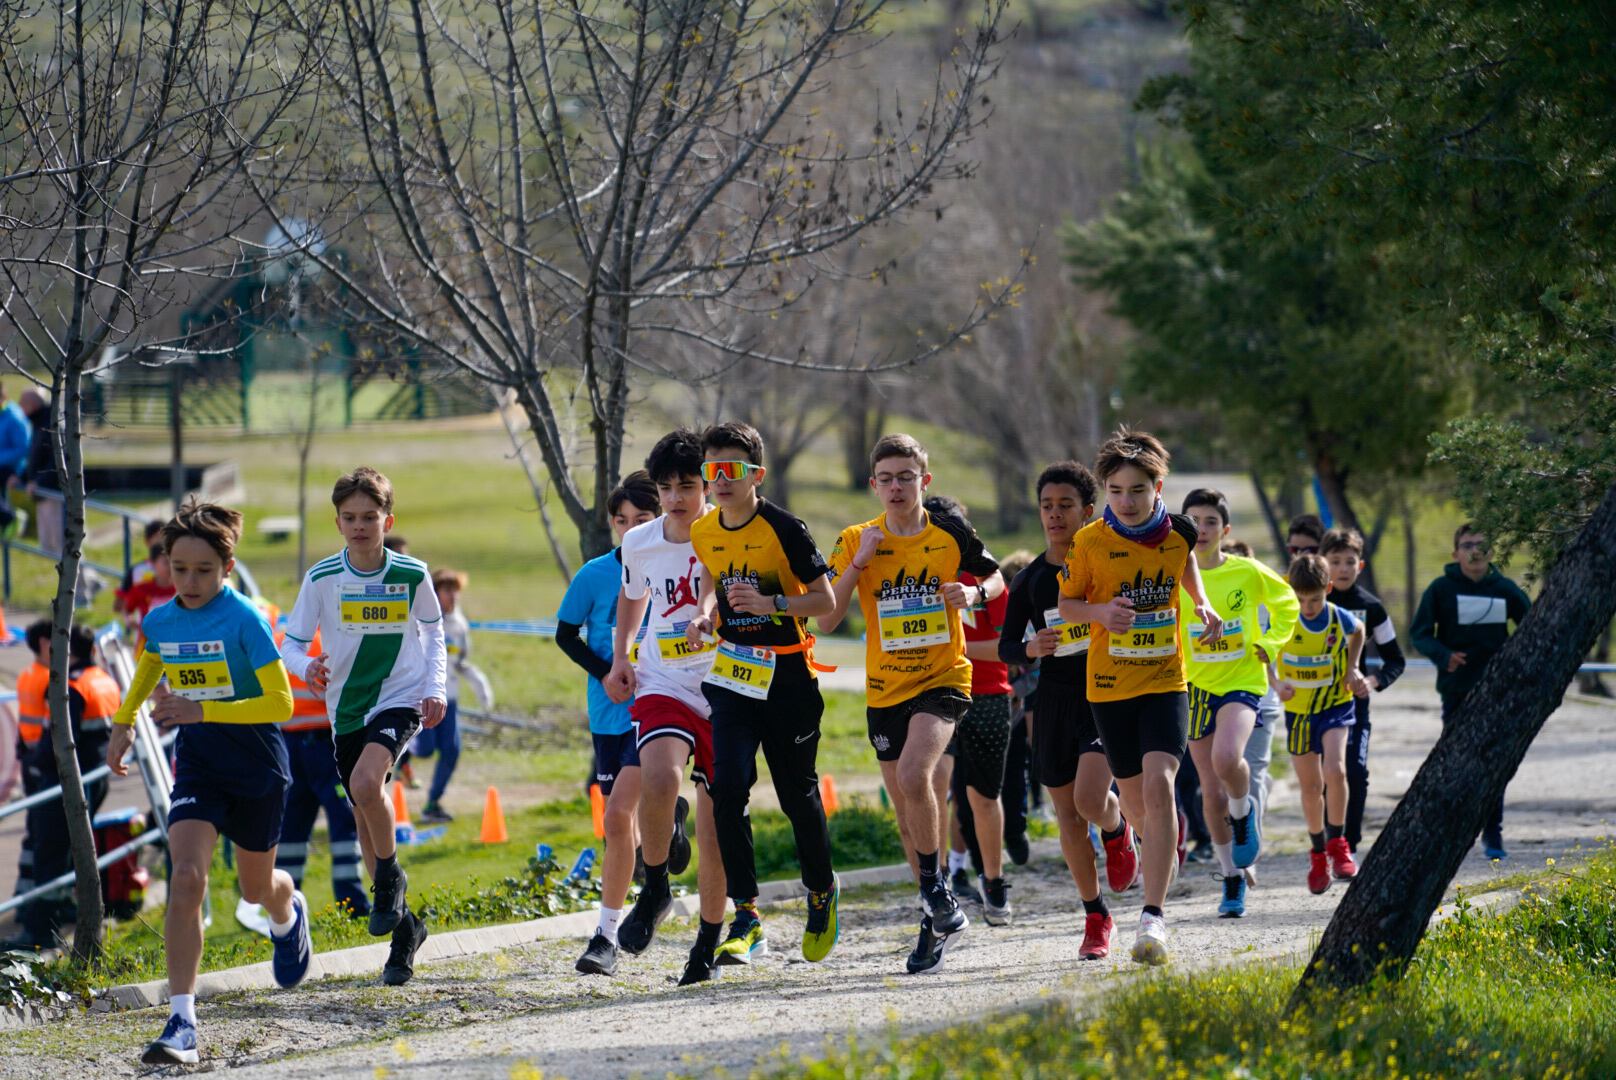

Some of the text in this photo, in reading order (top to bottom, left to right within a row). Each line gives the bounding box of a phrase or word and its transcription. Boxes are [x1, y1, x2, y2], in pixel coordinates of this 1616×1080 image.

[722, 576, 758, 586] PERLAS
[881, 585, 937, 598] PERLAS
[1121, 585, 1171, 598] PERLAS
[362, 606, 388, 620] 680
[727, 615, 771, 626] SAFEPOOL
[902, 618, 928, 635] 829
[1067, 622, 1091, 640] 102
[1132, 632, 1156, 646] 374
[1209, 639, 1229, 652] 915
[897, 648, 929, 656] HYUNDAI
[879, 663, 934, 673] VITALDENT
[1112, 659, 1169, 667] VITALDENT
[178, 668, 207, 686] 535
[731, 663, 753, 682] 827
[1295, 670, 1318, 680] 1108
